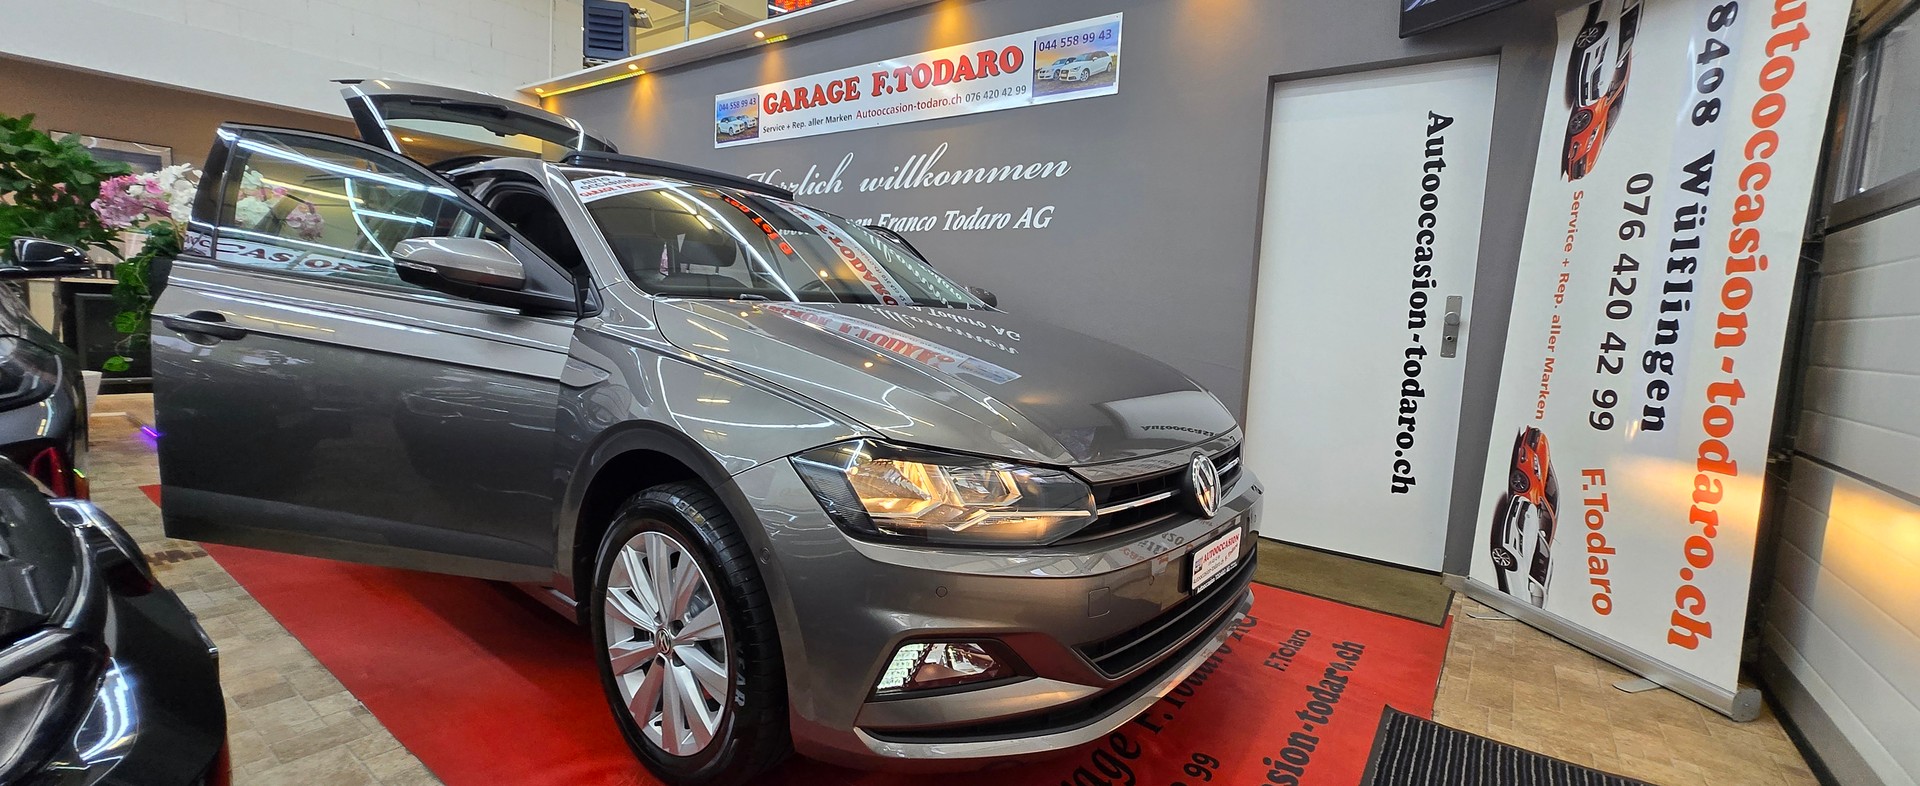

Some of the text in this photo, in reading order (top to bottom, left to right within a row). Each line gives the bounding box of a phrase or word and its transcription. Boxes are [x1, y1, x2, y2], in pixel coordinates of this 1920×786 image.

[1038, 28, 1112, 52] 044 558 99 43
[762, 123, 786, 134] Service
[792, 121, 807, 131] Rep.
[808, 118, 824, 127] aller
[825, 113, 853, 124] Marken
[856, 93, 962, 120] Autooccasion-todaro.ch
[965, 92, 981, 103] 076
[983, 88, 1000, 100] 420
[1001, 86, 1013, 97] 42
[1015, 84, 1027, 95] 99
[763, 45, 1024, 115] GARAGE F.TODARO
[859, 142, 1072, 193] willkommen
[878, 213, 938, 233] Franco
[942, 206, 1012, 231] Todaro
[1012, 205, 1056, 230] AG
[1563, 189, 1585, 253] Service
[1641, 1, 1739, 433] 8408 Wülflingen
[1391, 110, 1454, 495] Autooccasion-todaro.ch
[1553, 272, 1570, 309] Rep.
[1588, 172, 1655, 432] 076 420 42 99
[1547, 314, 1562, 352] aller
[1535, 357, 1556, 420] Marken
[1580, 467, 1617, 617] F.Todaro
